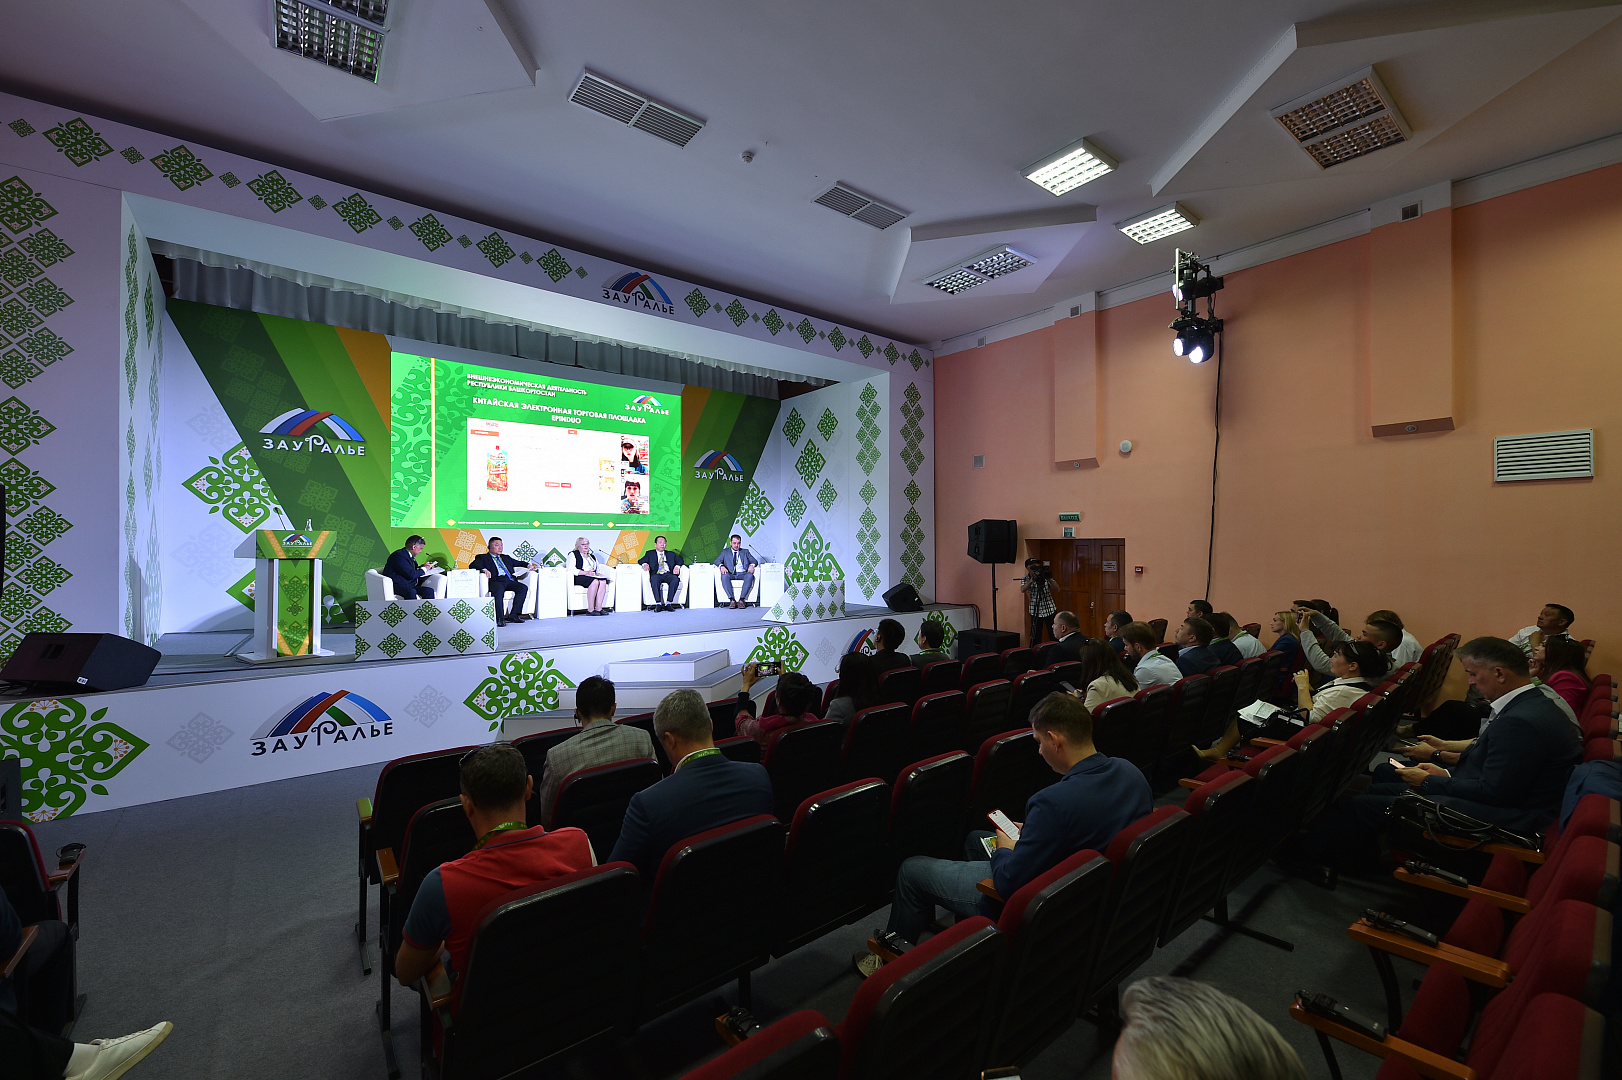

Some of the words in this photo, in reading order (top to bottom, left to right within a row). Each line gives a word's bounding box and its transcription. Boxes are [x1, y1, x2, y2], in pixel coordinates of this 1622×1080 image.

[602, 289, 675, 315] ЗАУРАЛЬЕ
[466, 373, 546, 390] ВНЕШНЕЭКОНОМИЧЕСКАЯ
[546, 385, 588, 396] ДЕЯТЕЛЬНОСТЬ
[466, 380, 508, 391] РЕСПУБЛИКИ
[508, 385, 556, 398] БАШКОРТОСТАН
[472, 396, 519, 409] КИТАЙСКАЯ
[520, 402, 572, 415] ЭЛЕКТРОННАЯ
[573, 409, 608, 420] ТОРГОВАЯ
[608, 413, 647, 424] ПЛОЩАДКА
[551, 414, 582, 424] EPINDUO
[624, 403, 670, 416] ЗАУРАЛЬЕ
[262, 434, 366, 456] ЗАУРАЛЬЕ
[694, 467, 744, 482] ЗАУРАЛЬЕ
[250, 720, 393, 756] ЗАУРАЛЬЕ
